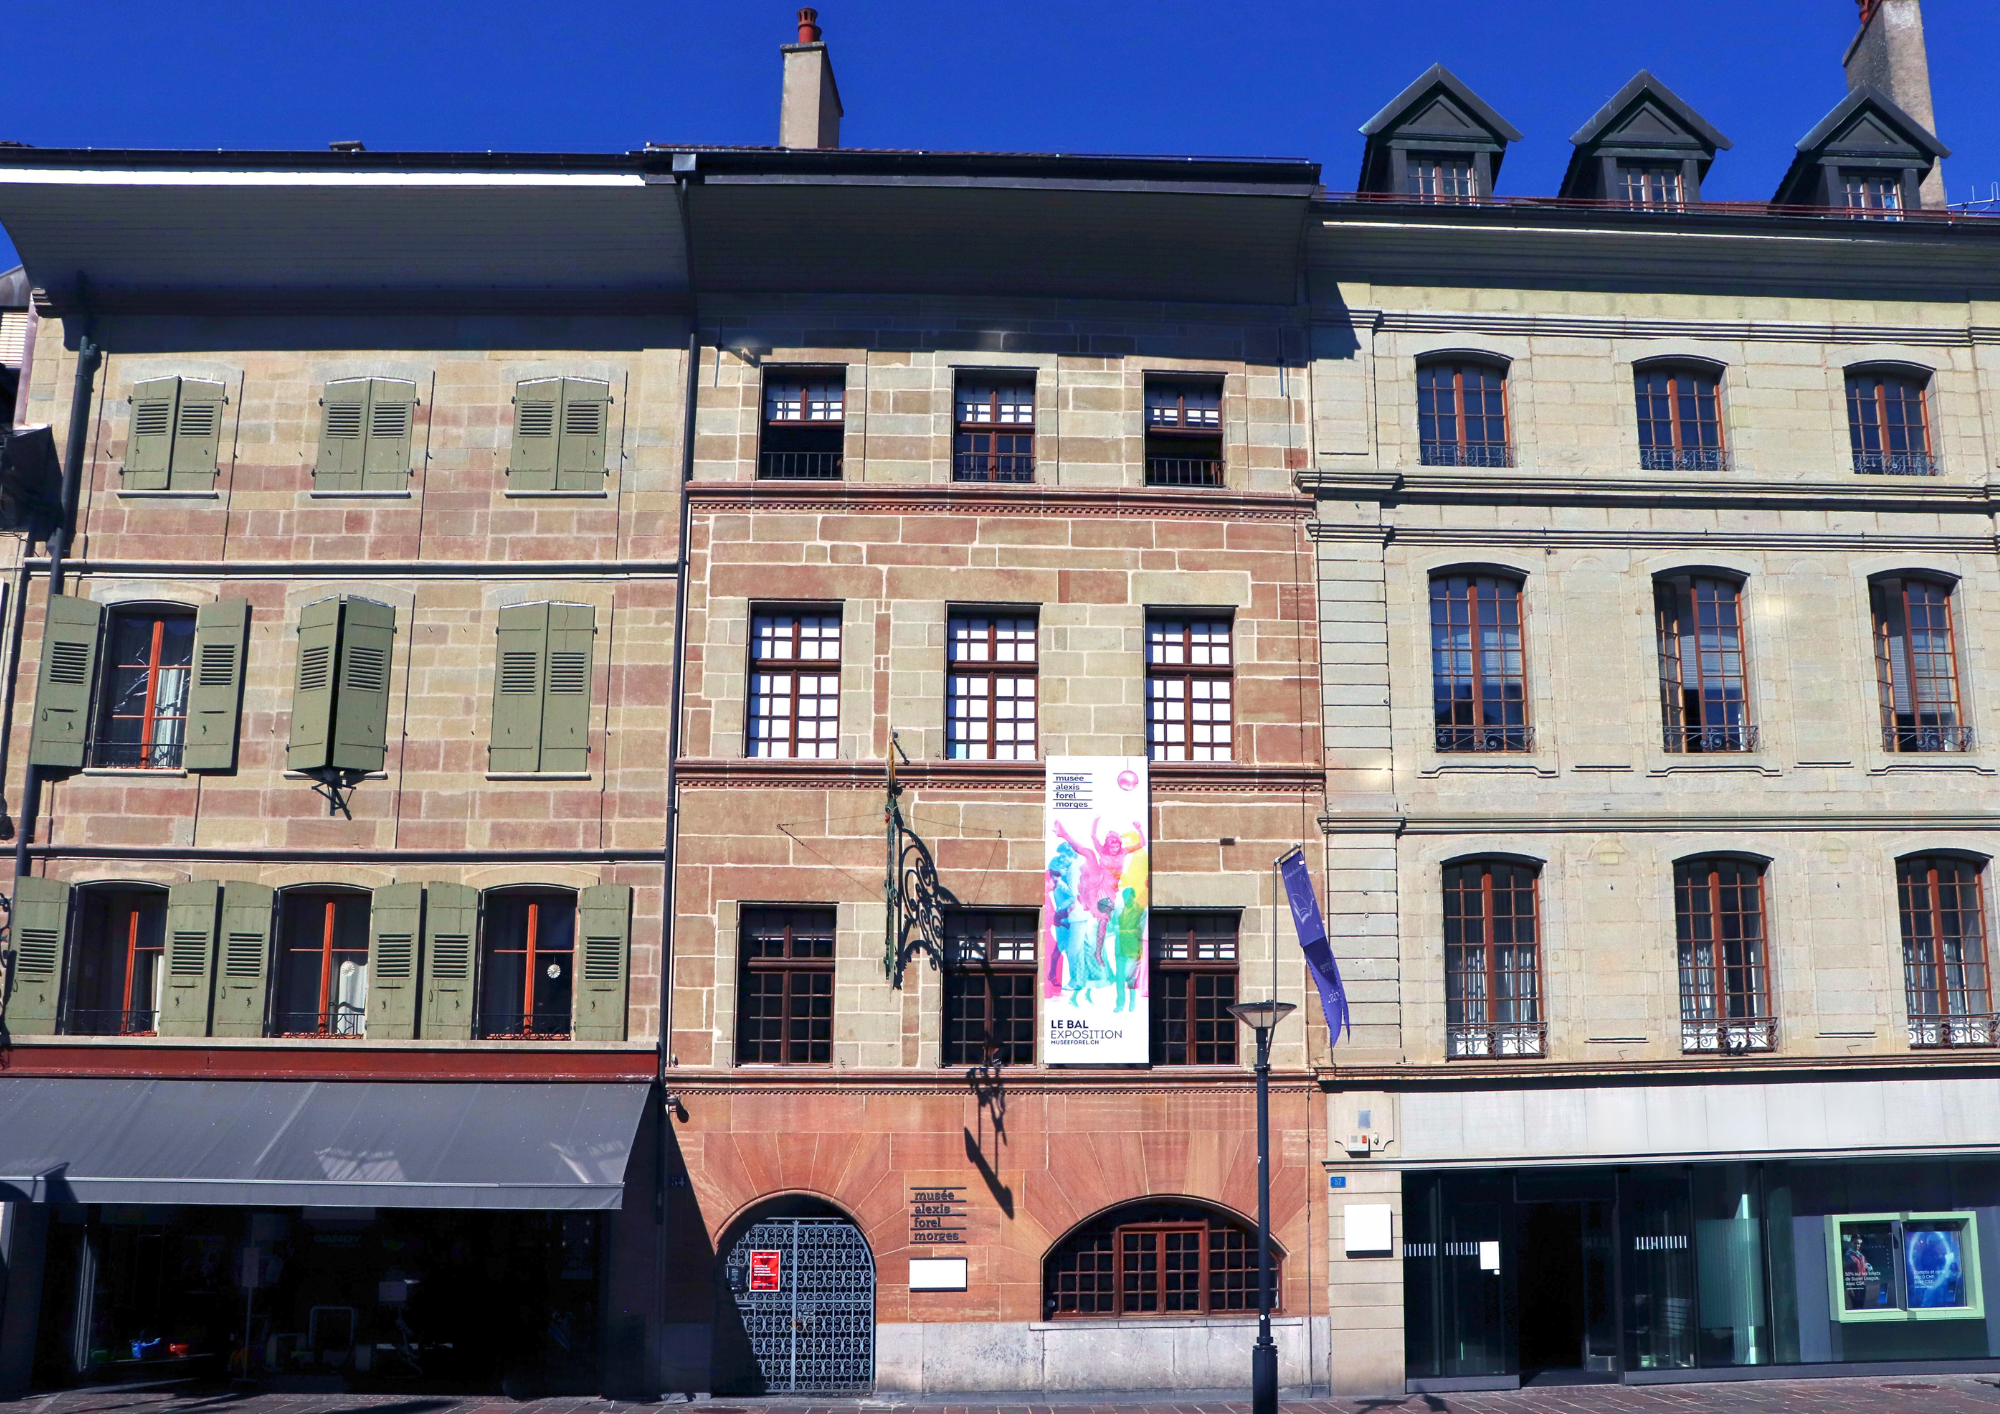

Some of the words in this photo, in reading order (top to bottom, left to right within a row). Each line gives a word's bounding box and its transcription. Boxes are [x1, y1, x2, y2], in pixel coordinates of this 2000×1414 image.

[1051, 1020, 1064, 1028] LE
[1067, 1020, 1089, 1028] BAL
[1051, 1030, 1122, 1039] EXPOSITION
[914, 1189, 955, 1201] musée
[914, 1204, 951, 1214] alexis
[914, 1217, 941, 1227] forel
[914, 1232, 959, 1241] morges
